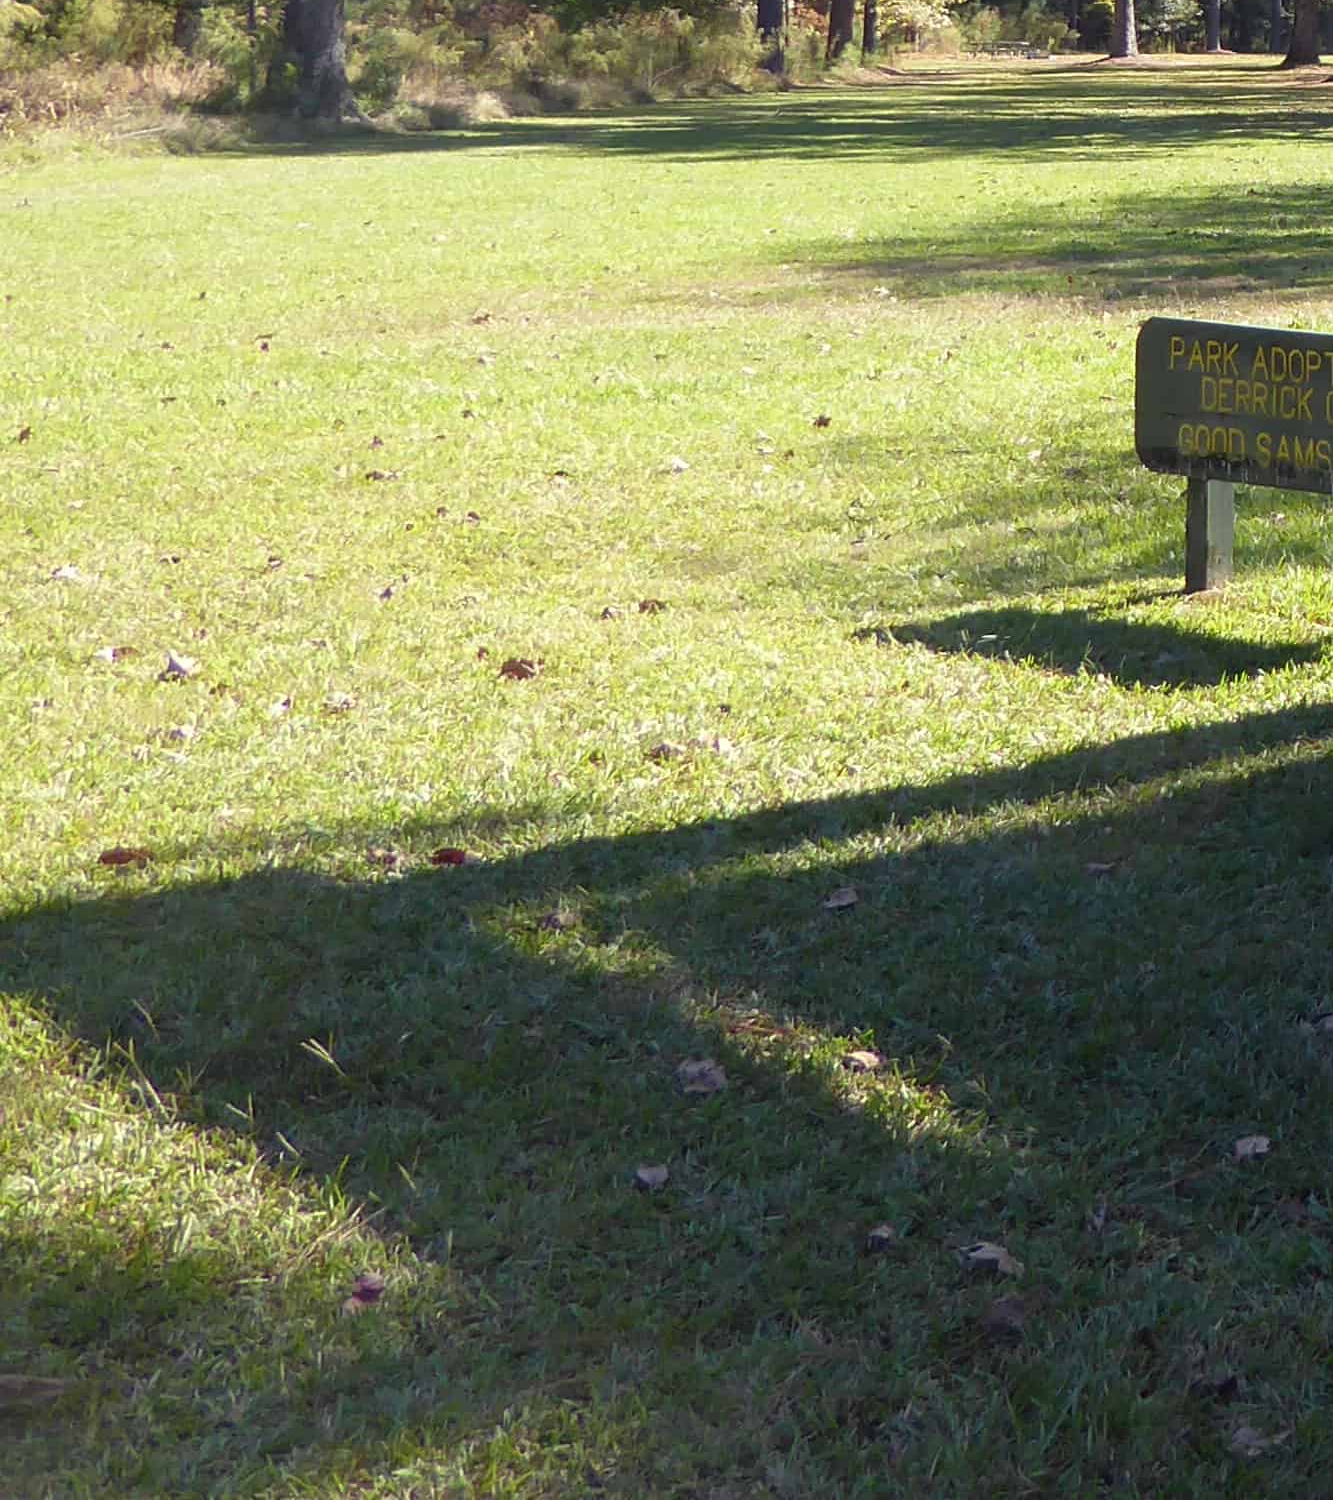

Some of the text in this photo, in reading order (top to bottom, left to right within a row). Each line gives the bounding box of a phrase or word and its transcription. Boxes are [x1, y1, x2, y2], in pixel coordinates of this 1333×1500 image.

[1168, 336, 1240, 374] PARK
[1200, 376, 1313, 423] DERRICK
[1178, 423, 1246, 462] GOOD
[1256, 432, 1332, 471] SAMS
